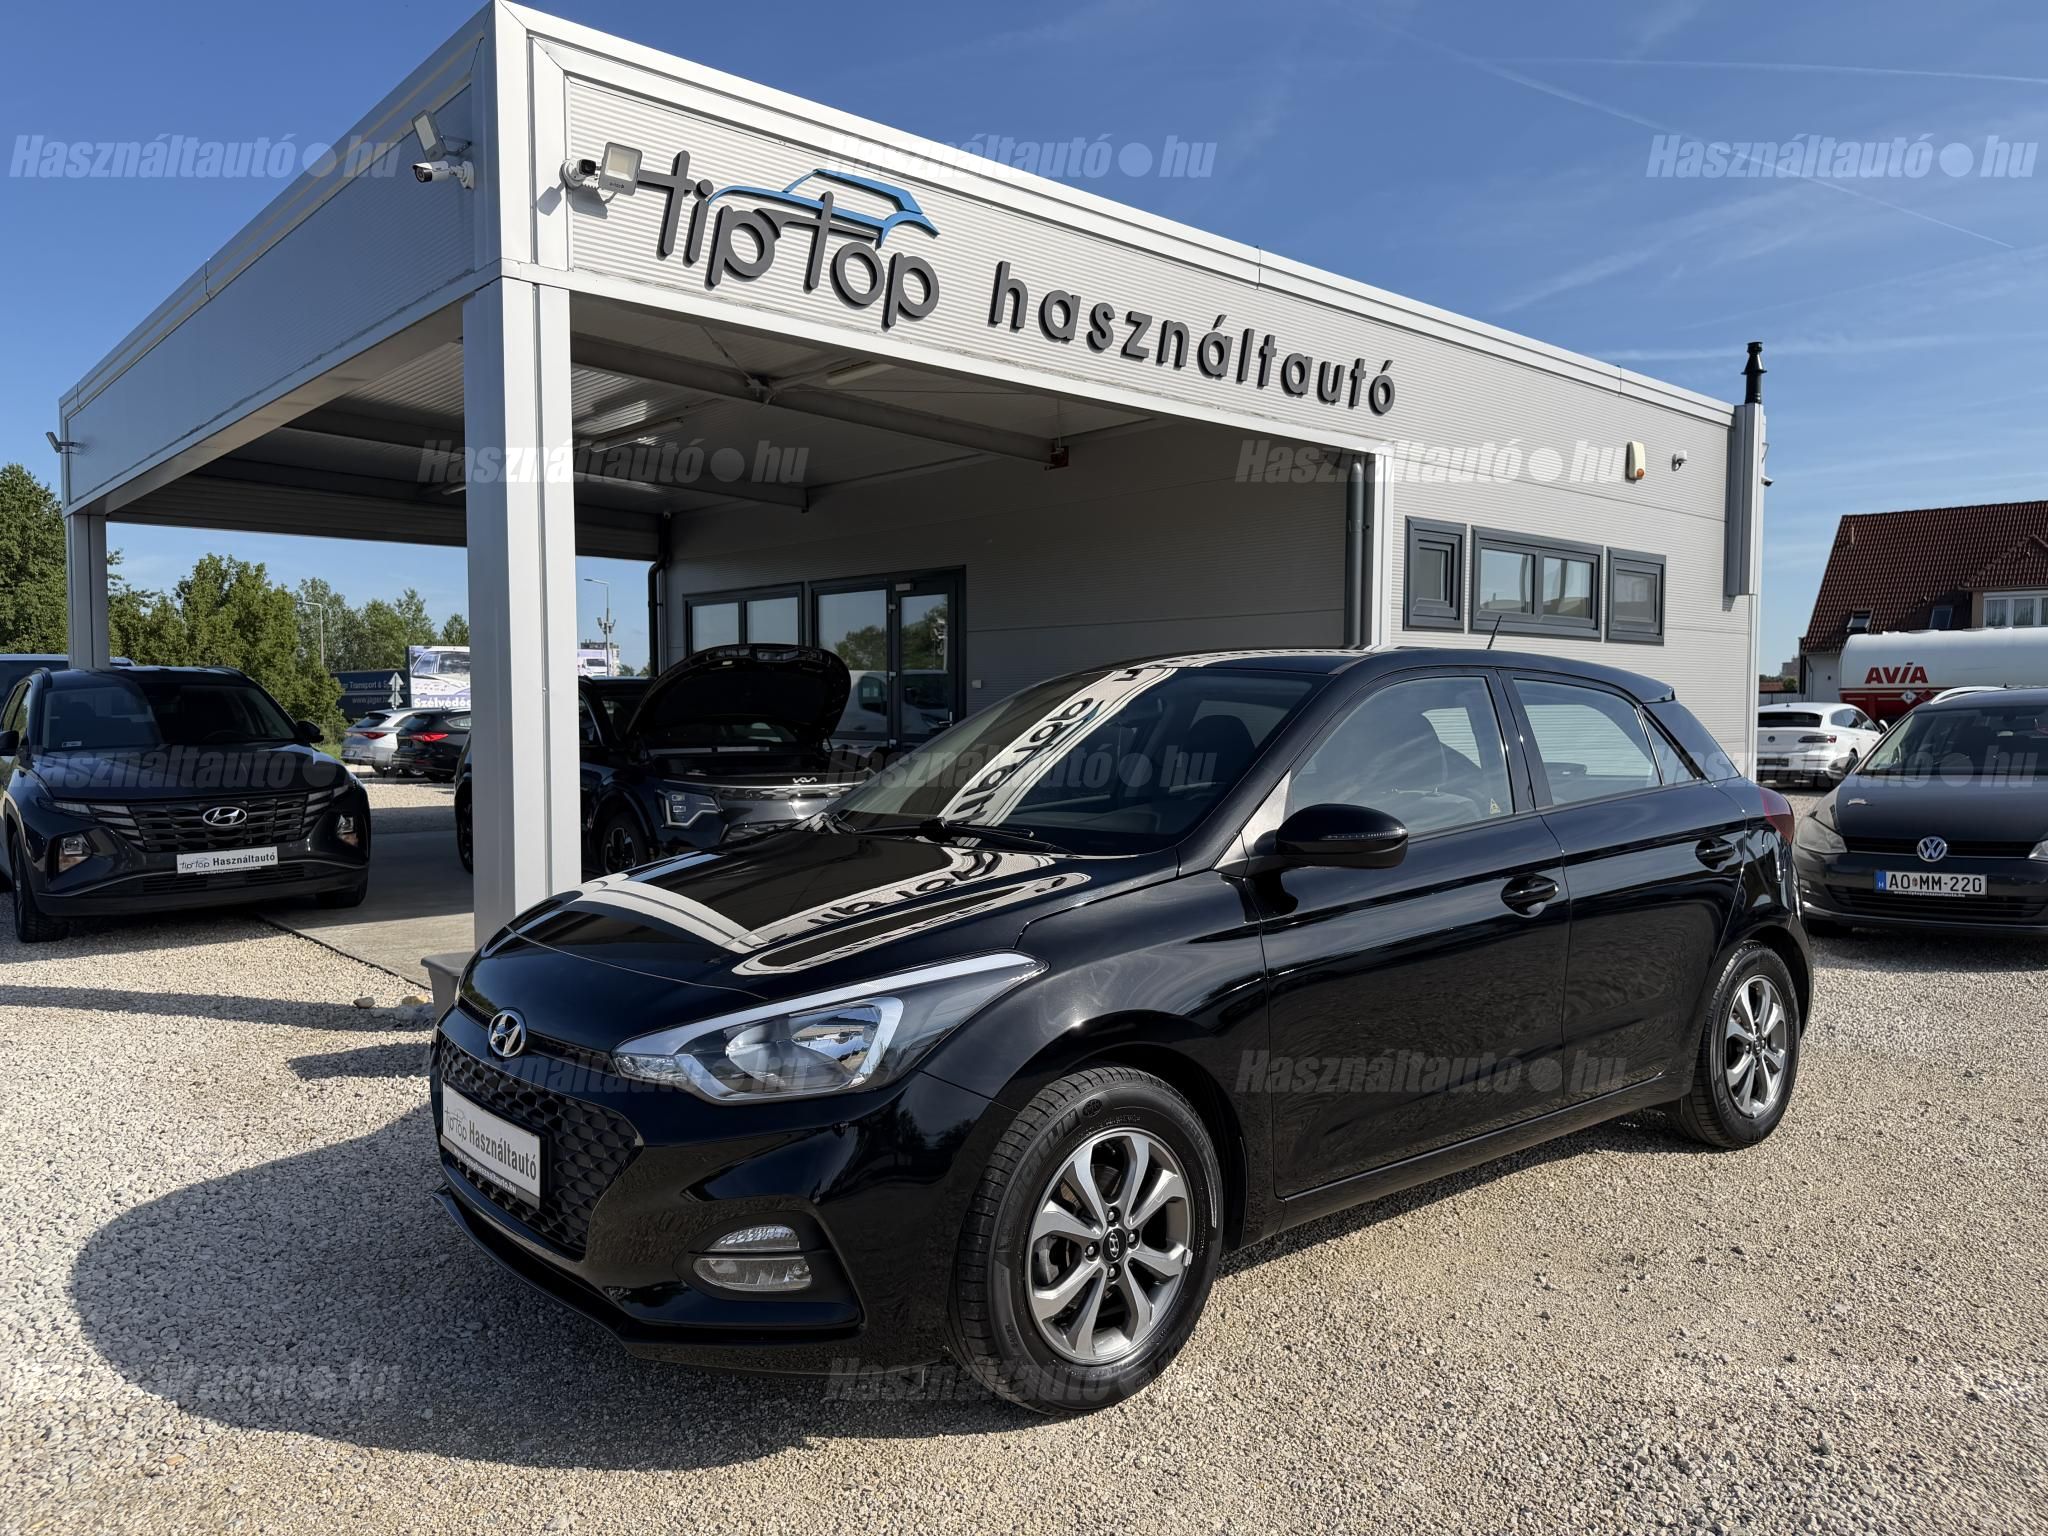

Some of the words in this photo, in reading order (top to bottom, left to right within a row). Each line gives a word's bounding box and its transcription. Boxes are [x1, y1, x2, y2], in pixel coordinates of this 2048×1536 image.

[989, 261, 1397, 414] használtautó
[212, 852, 276, 866] Használtautó
[468, 1119, 537, 1181] Használtautó
